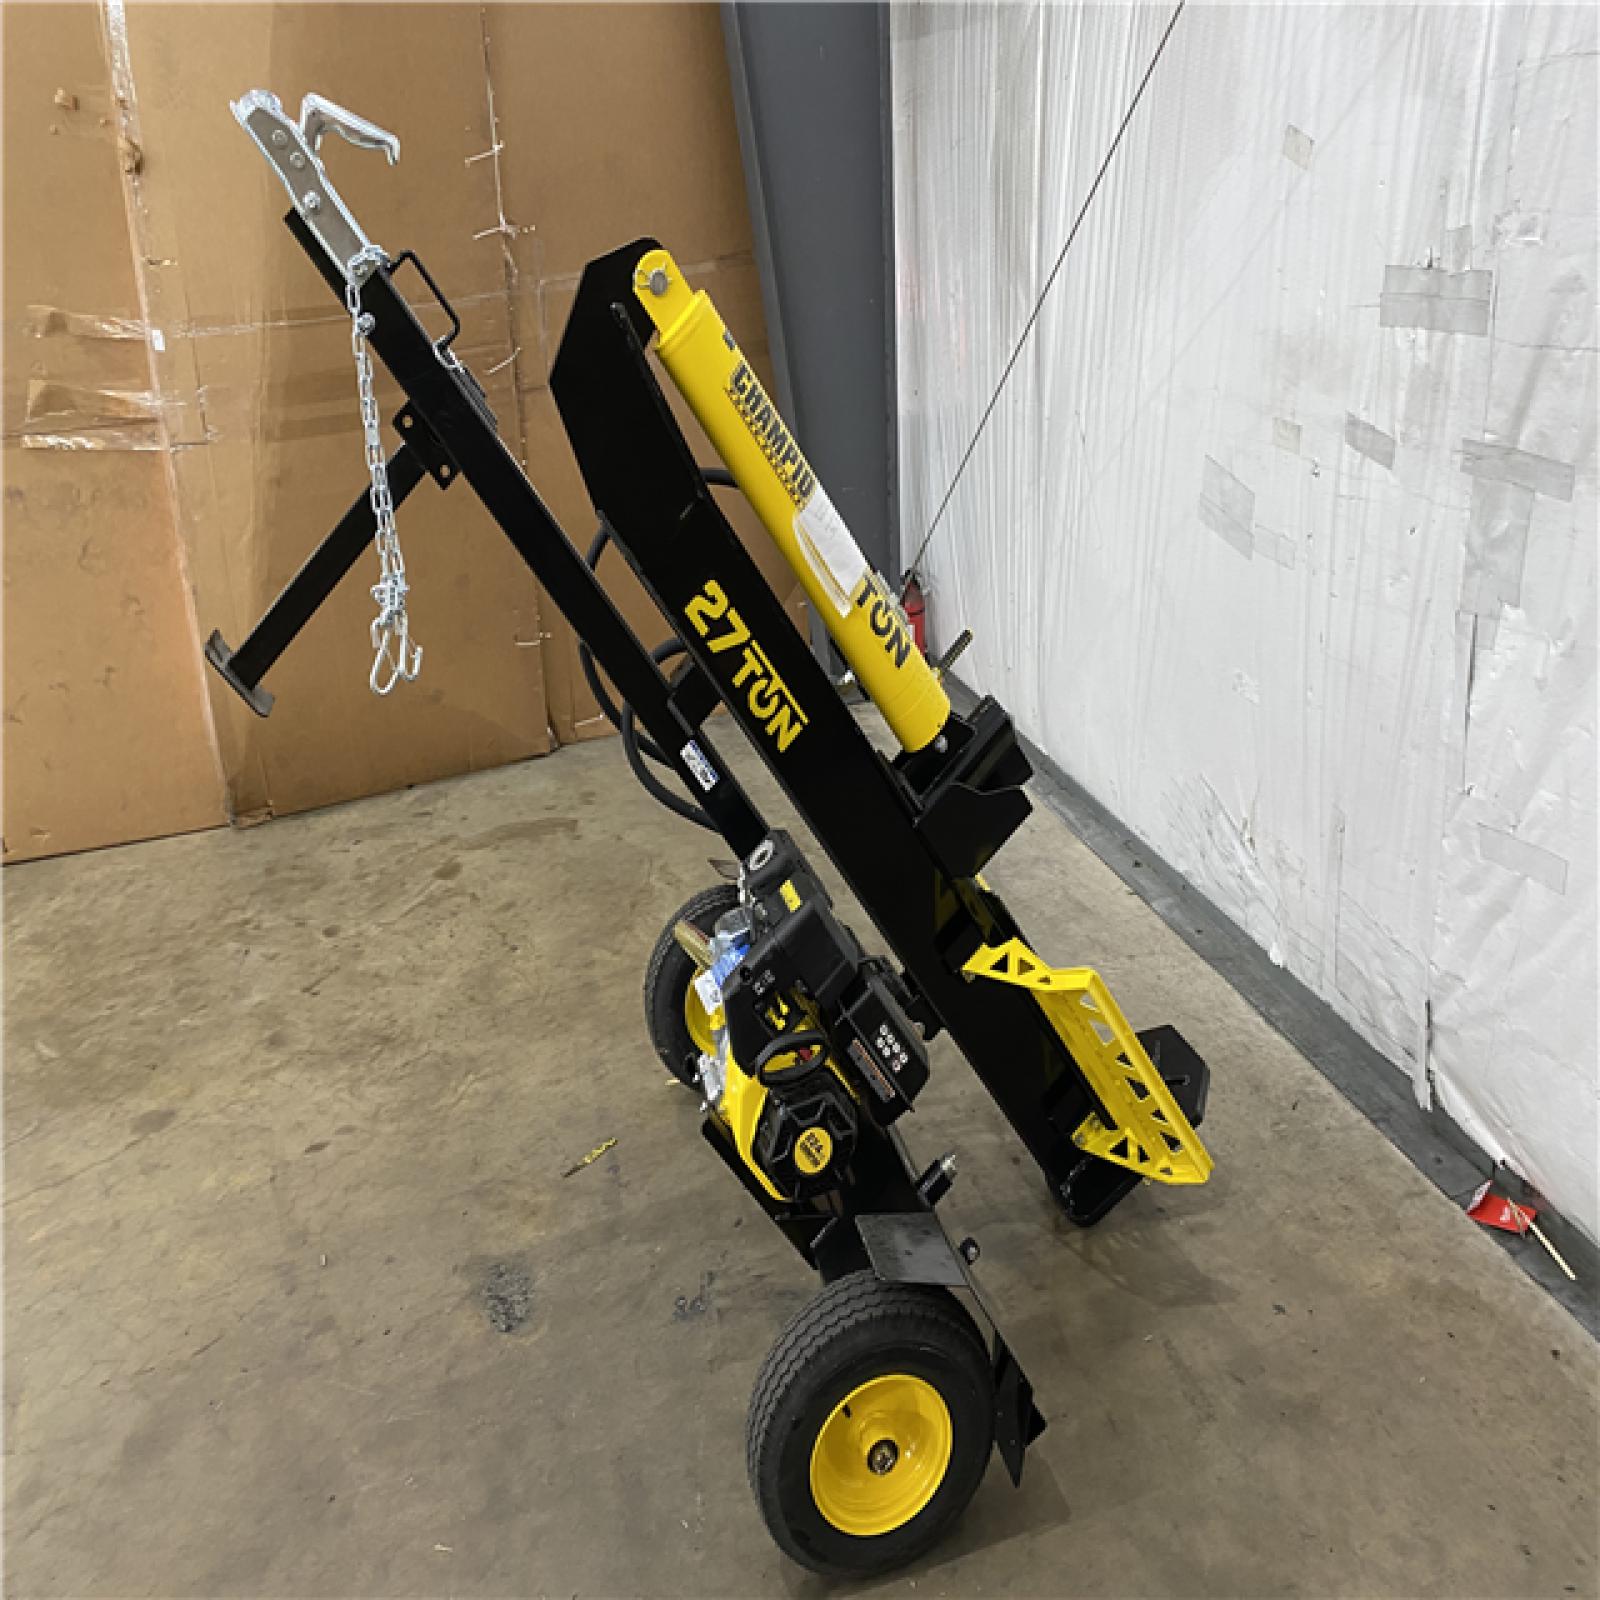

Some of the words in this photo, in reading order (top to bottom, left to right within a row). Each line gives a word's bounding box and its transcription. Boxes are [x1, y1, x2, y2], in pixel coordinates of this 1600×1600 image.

[732, 363, 817, 498] CHAMPIO
[684, 578, 751, 653] 27
[731, 639, 810, 753] TON
[856, 576, 911, 668] TON
